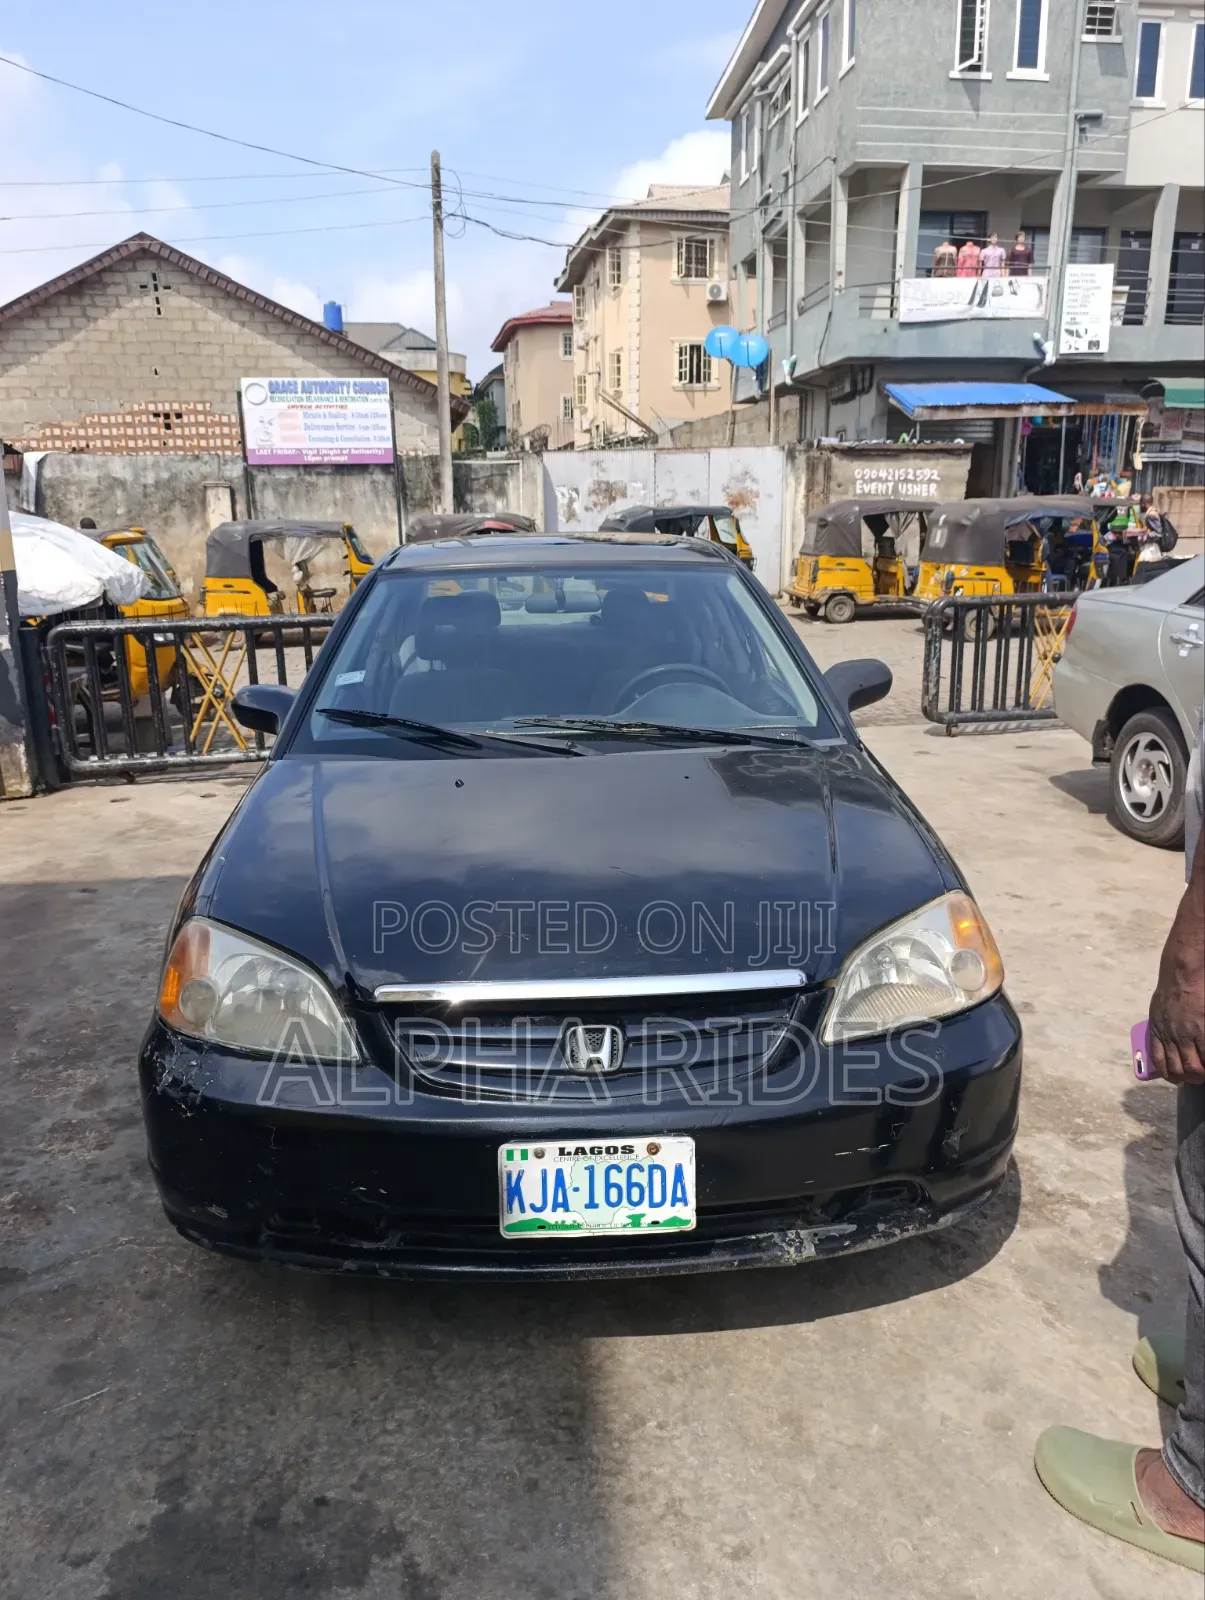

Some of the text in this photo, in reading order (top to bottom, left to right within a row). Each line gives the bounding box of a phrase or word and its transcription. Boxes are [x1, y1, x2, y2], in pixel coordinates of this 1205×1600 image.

[301, 381, 351, 395] AUTHORITY
[353, 381, 388, 395] CHURCH
[854, 468, 941, 481] 09042152592
[856, 480, 938, 497] EVENT USHER
[558, 1145, 635, 1156] LAGOS
[506, 1162, 689, 1214] KJA-166DA
